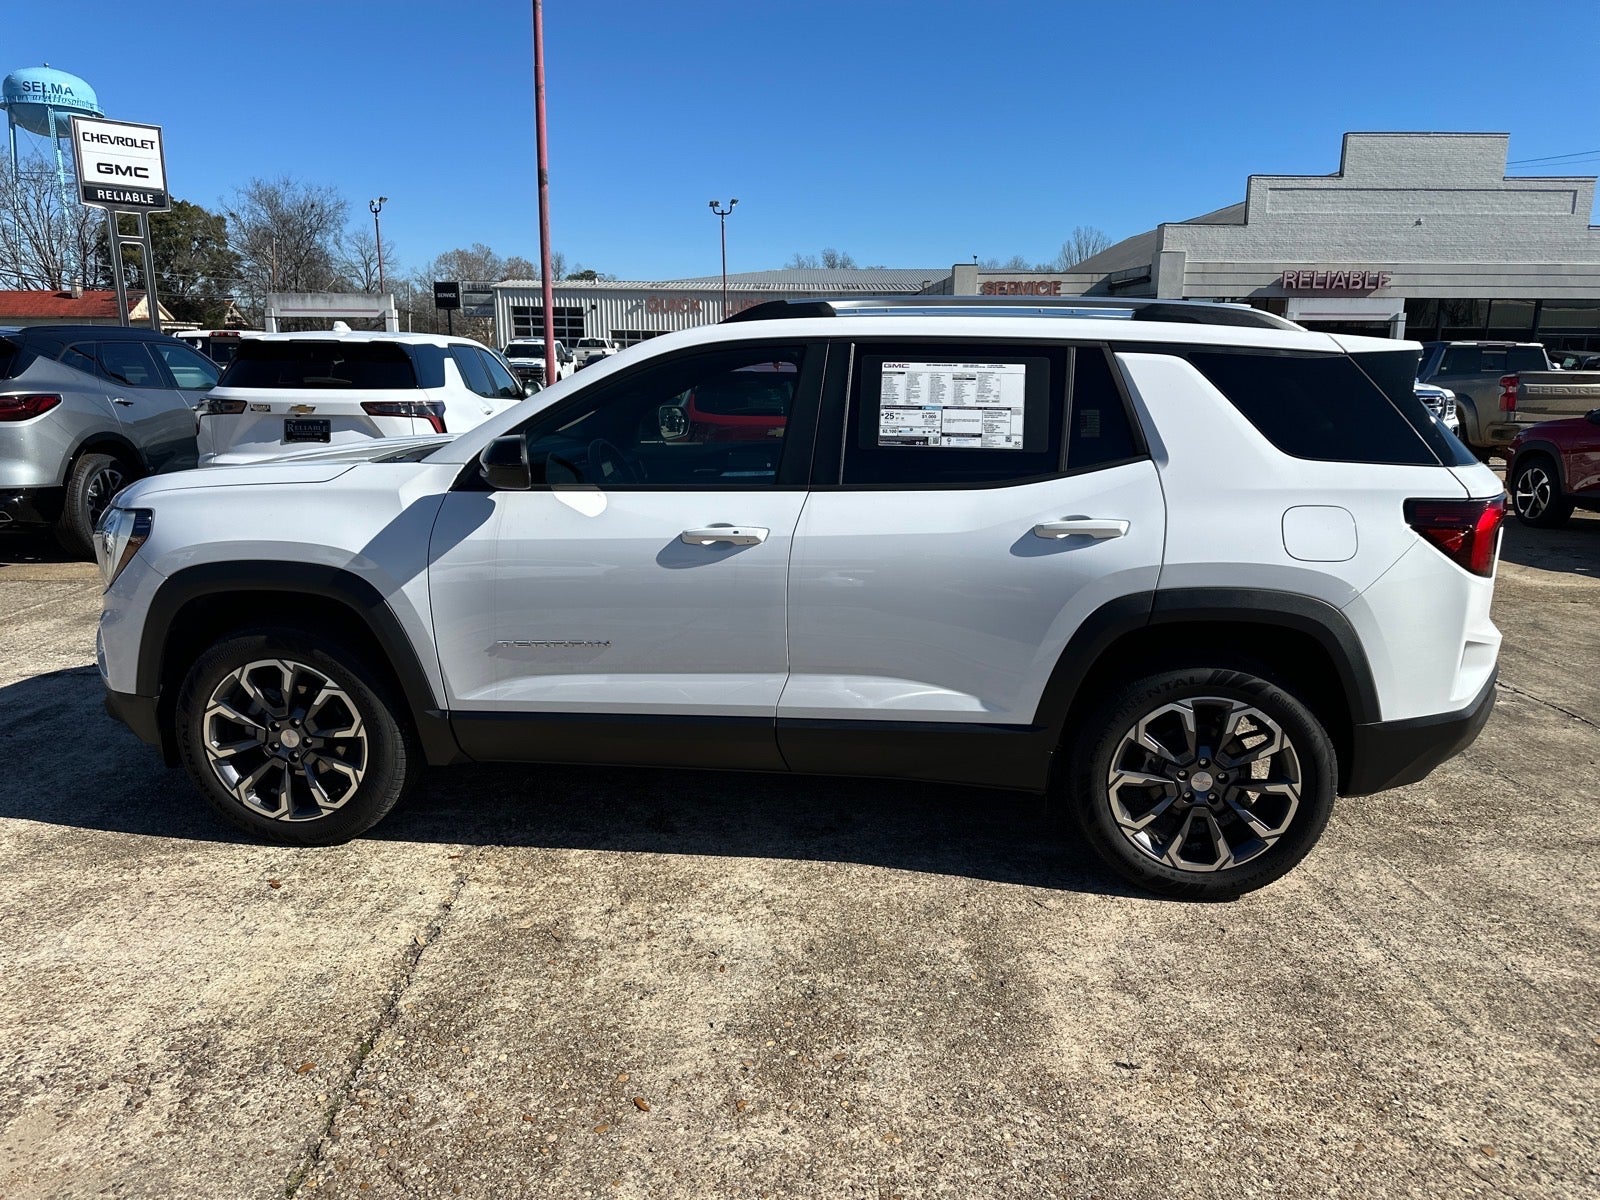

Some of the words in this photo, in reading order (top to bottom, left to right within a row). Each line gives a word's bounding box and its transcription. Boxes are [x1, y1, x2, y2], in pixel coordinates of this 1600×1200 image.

[22, 80, 75, 97] SELMA
[82, 131, 156, 150] CHEVROLET
[96, 162, 149, 179] GMC
[97, 189, 154, 204] RELIABLE
[1282, 269, 1393, 290] RELIABLE
[982, 280, 1063, 297] SERVICE
[884, 412, 895, 420] 25
[287, 423, 329, 433] RELIABLE
[496, 639, 611, 648] TERRAIN
